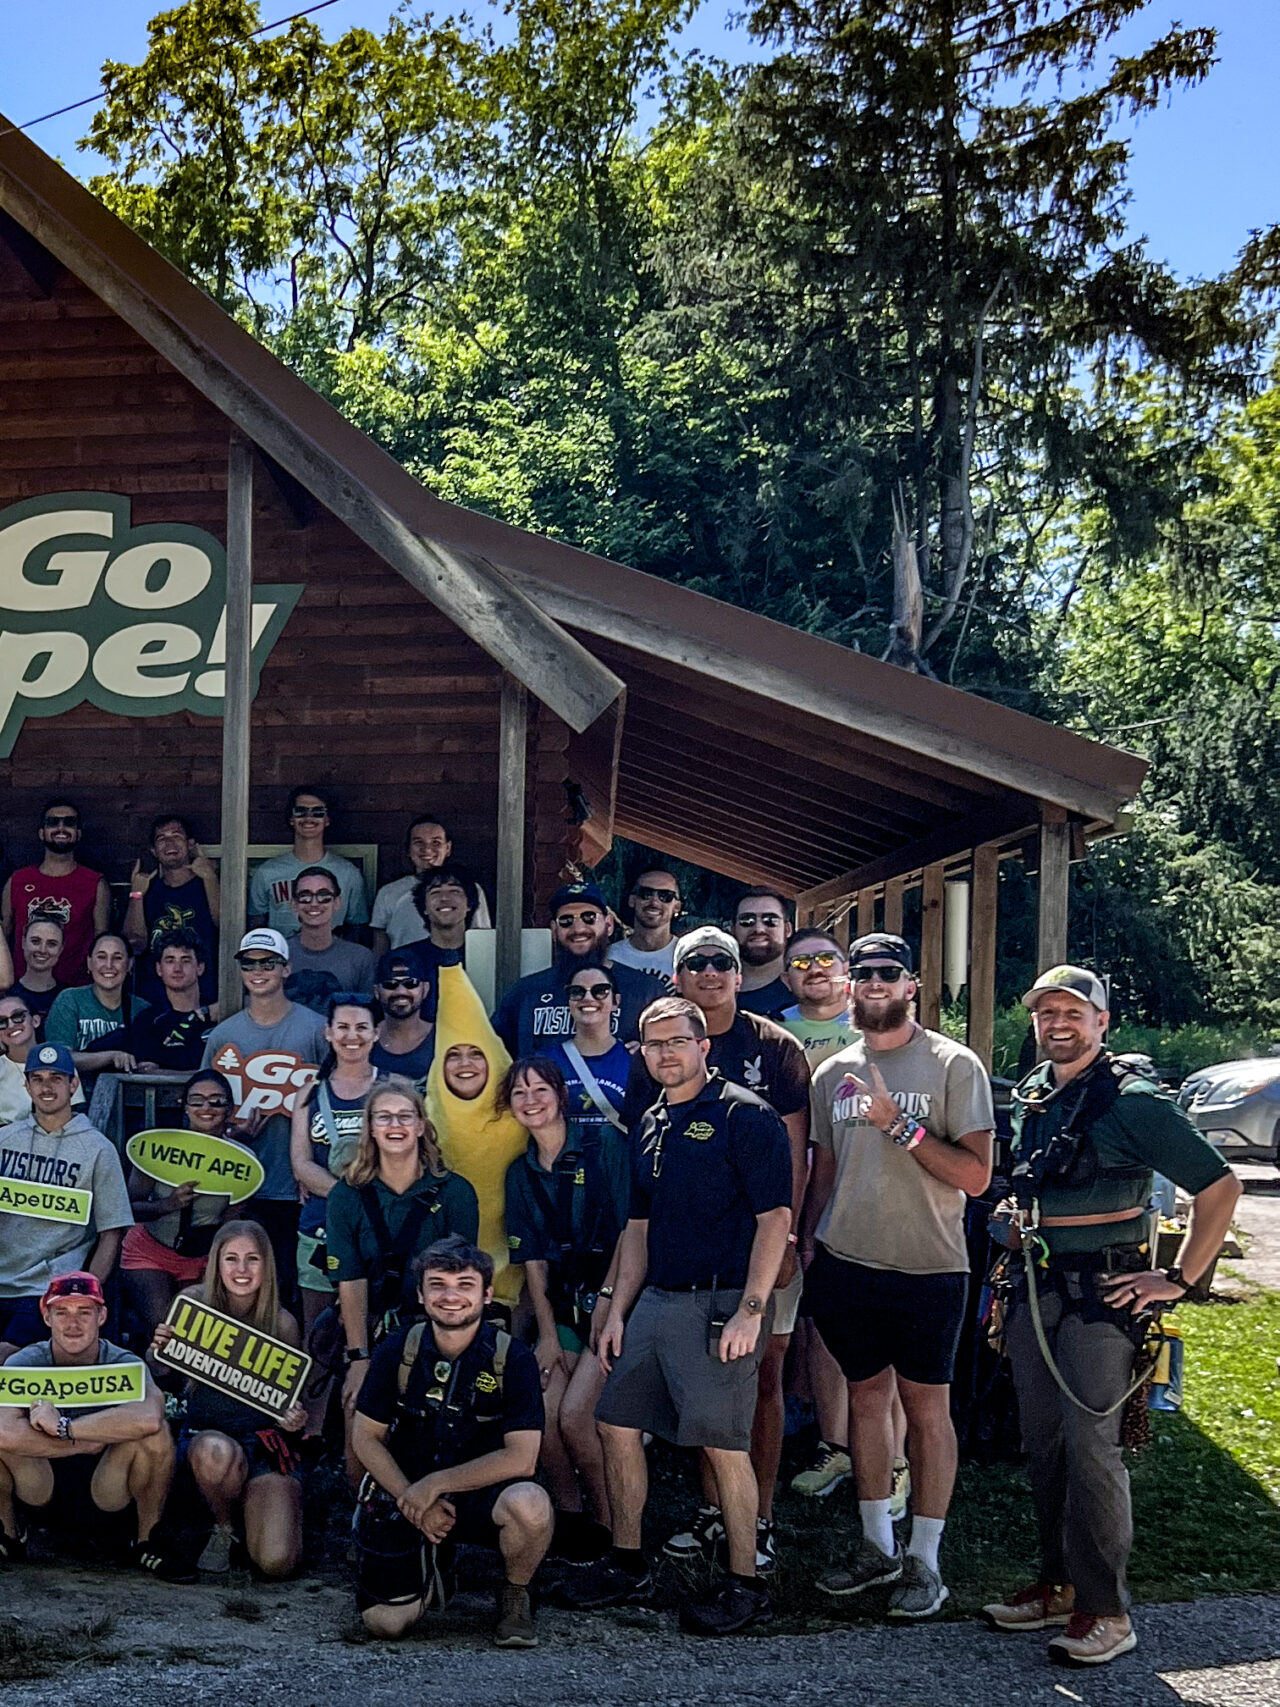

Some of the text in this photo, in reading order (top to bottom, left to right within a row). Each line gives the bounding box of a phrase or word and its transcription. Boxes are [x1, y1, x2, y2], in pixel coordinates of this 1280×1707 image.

[0, 1148, 82, 1189] VISITORS
[139, 1140, 251, 1182] I WENT APE!
[162, 1338, 289, 1410] ADVENTUROUSLY
[173, 1303, 302, 1390] LIVE LIFE
